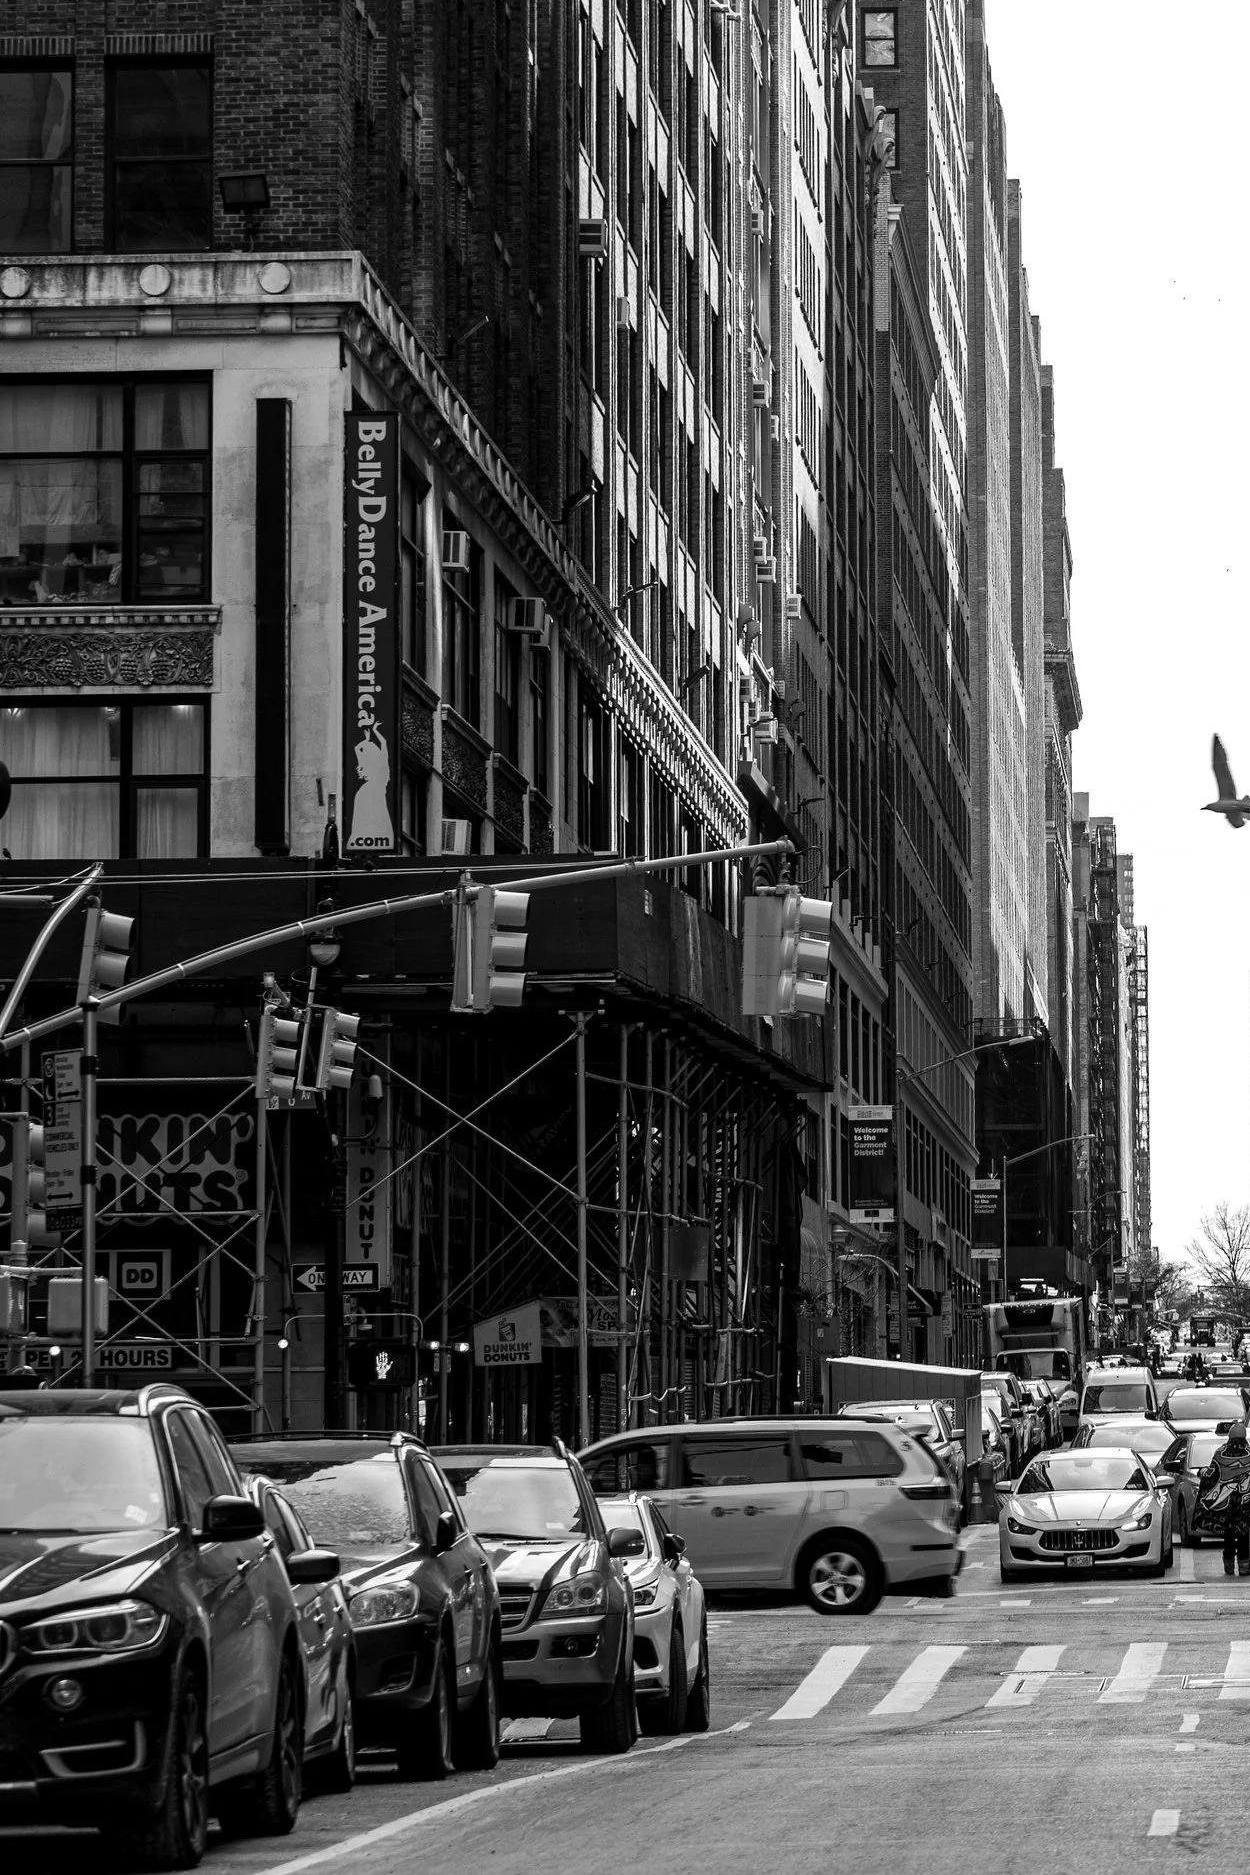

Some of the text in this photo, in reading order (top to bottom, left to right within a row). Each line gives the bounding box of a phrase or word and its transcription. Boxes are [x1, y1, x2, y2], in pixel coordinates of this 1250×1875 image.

[358, 601, 389, 728] America
[350, 834, 390, 848] .com
[126, 1268, 155, 1285] DD
[308, 1272, 326, 1284] ON
[484, 1342, 534, 1355] DUNKIN'
[100, 1349, 169, 1368] HOURS
[484, 1352, 531, 1364] DONUTS
